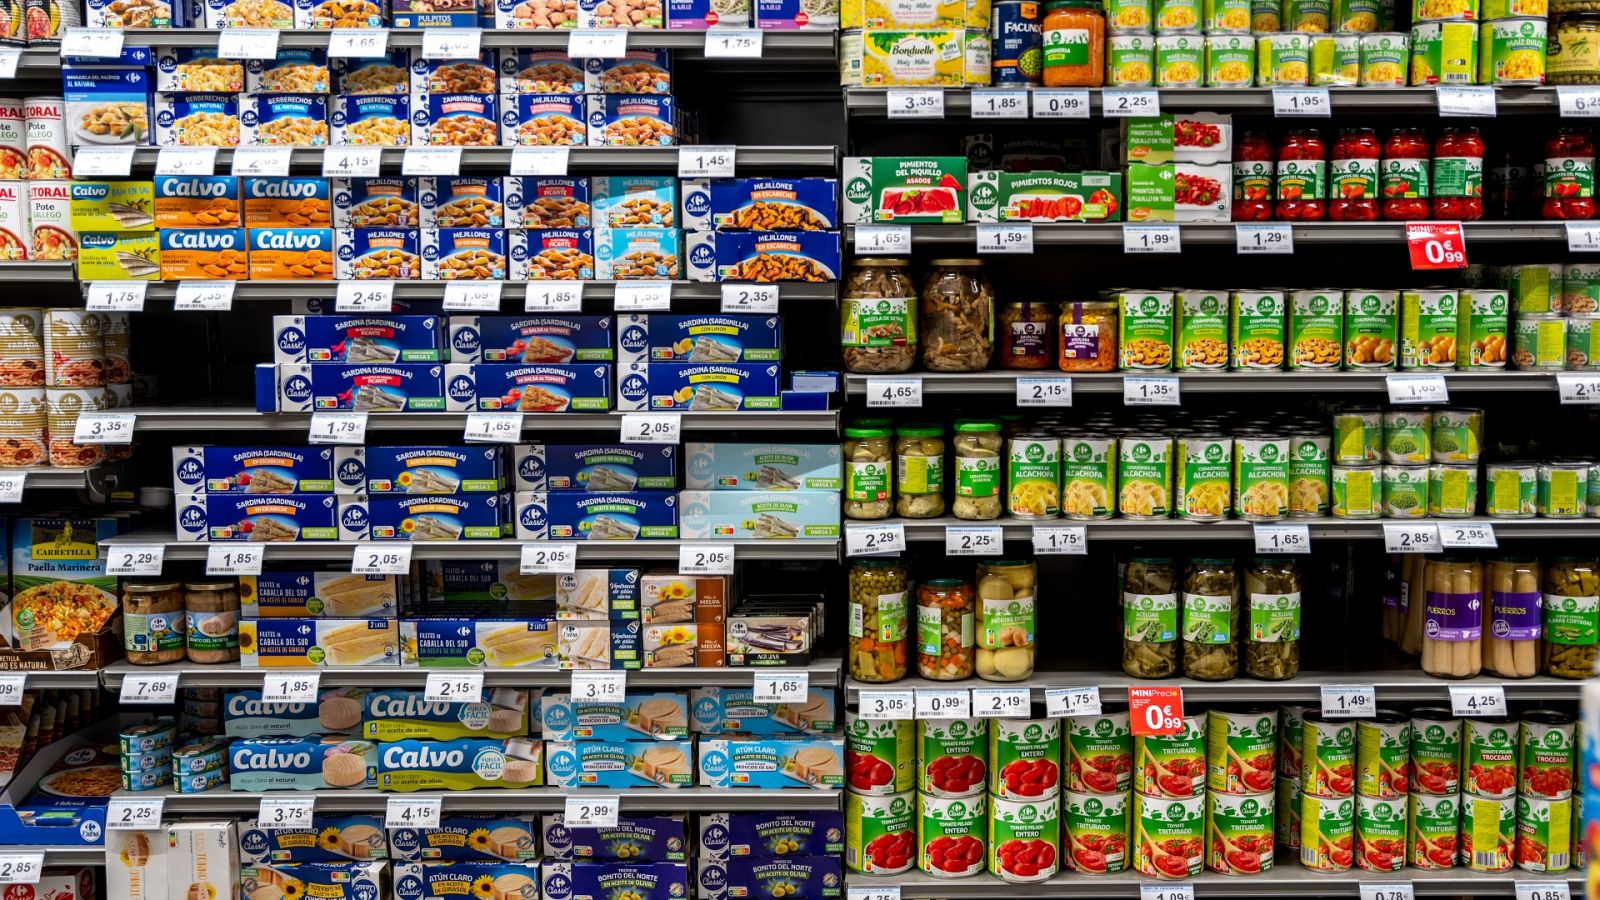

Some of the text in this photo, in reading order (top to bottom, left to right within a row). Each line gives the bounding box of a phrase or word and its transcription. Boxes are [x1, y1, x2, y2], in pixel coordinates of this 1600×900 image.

[892, 44, 934, 57] Bonduelle
[268, 97, 312, 105] BERBERECHOS
[162, 179, 227, 197] Calvo
[252, 180, 317, 197] Calvo
[1011, 179, 1078, 190] PIMIENTOS ROJOS
[73, 186, 107, 197] Calvo
[82, 235, 115, 244] Calvo
[168, 231, 234, 248] Calvo
[257, 231, 321, 248] Calvo
[335, 320, 406, 330] SARDINA (SARDINILLA)
[510, 320, 581, 330] SARDINA (SARDINILLA)
[678, 319, 749, 330] SARDINA (SARDINILLA)
[342, 368, 413, 378] SARDINA (SARDINILLA)
[506, 367, 576, 378] SARDINA (SARDINILLA)
[679, 367, 750, 378] SARDINA (SARDINILLA)
[233, 450, 303, 462] SARDINA (SARDINILLA)
[396, 450, 467, 462] SARDINA (SARDINILLA)
[575, 450, 644, 460] SARDINA (SARDINILLA)
[28, 563, 100, 572] Paella Marinera
[1427, 606, 1456, 616] PUERROS
[228, 696, 306, 716] Calvo
[233, 749, 310, 769] Calvo
[383, 747, 464, 768] Calvo
[794, 820, 816, 828] NORTE
[887, 822, 908, 831] ENTERO
[274, 827, 319, 835] ATÚN CLARO
[445, 827, 468, 835] CLARO
[752, 864, 776, 873] BONITO
[790, 864, 812, 873] NORTE
